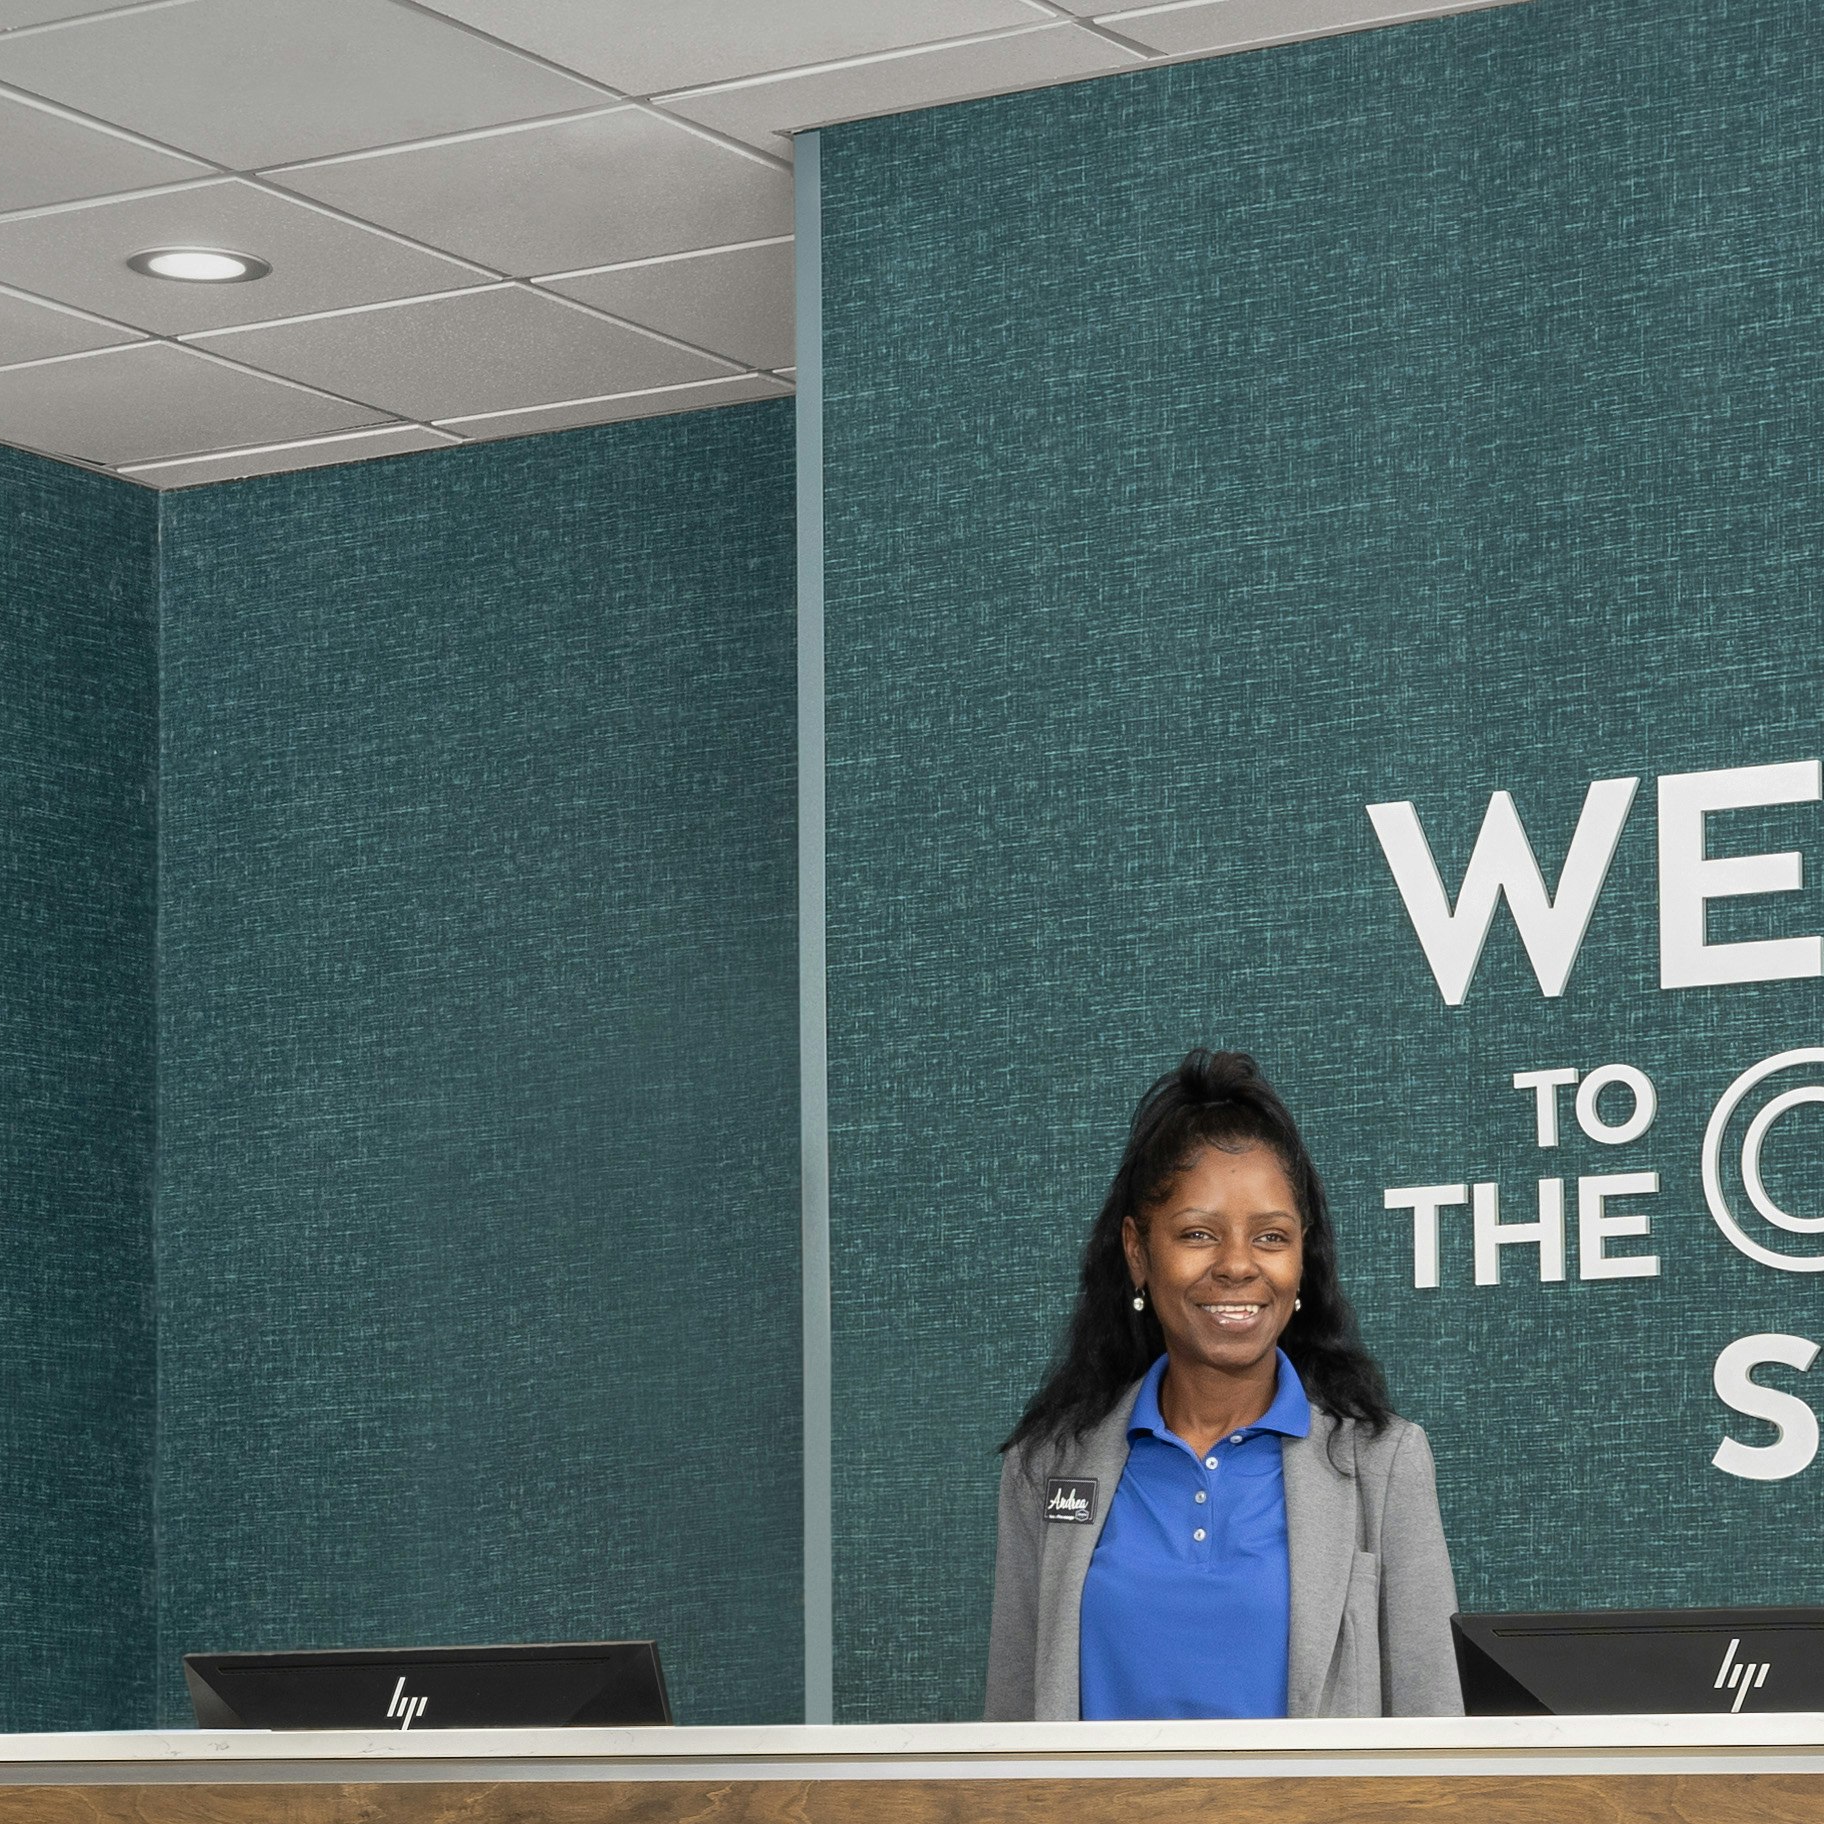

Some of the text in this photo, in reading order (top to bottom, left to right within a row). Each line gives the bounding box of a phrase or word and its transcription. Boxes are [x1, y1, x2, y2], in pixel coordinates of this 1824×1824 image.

[1512, 1063, 1656, 1148] TO
[1382, 1170, 1661, 1290] THE
[1047, 1487, 1090, 1511] Andrea
[386, 1676, 429, 1731] hp
[1713, 1638, 1772, 1714] hp
